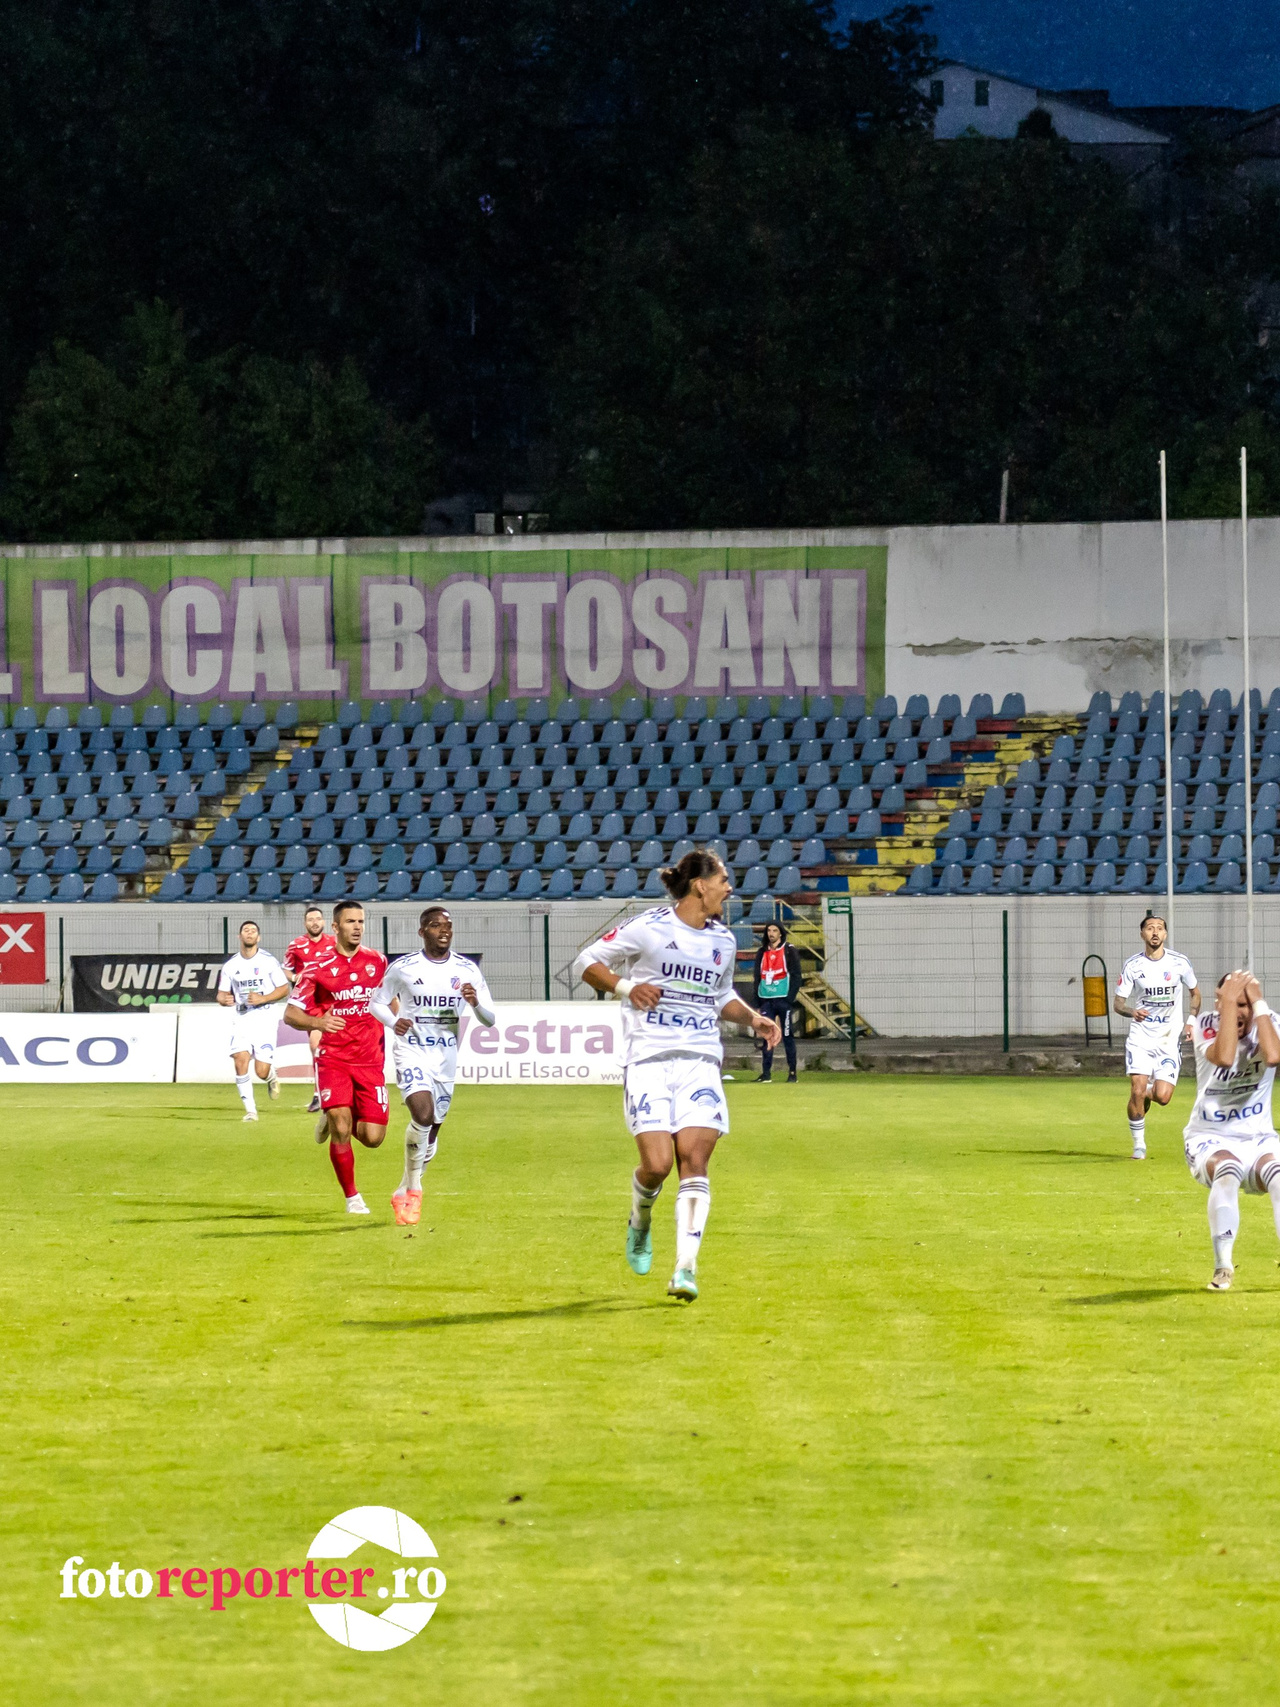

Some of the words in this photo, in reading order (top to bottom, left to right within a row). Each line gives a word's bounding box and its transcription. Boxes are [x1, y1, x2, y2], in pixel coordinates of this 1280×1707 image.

[41, 585, 341, 696] LOCAL
[367, 577, 859, 695] BOTOSANI
[101, 963, 224, 991] UNIBET
[661, 962, 721, 989] UNIBET
[413, 995, 463, 1007] UNIBET
[408, 1035, 457, 1047] ELSAC
[403, 1067, 423, 1083] 83
[519, 1061, 590, 1079] Elsaco
